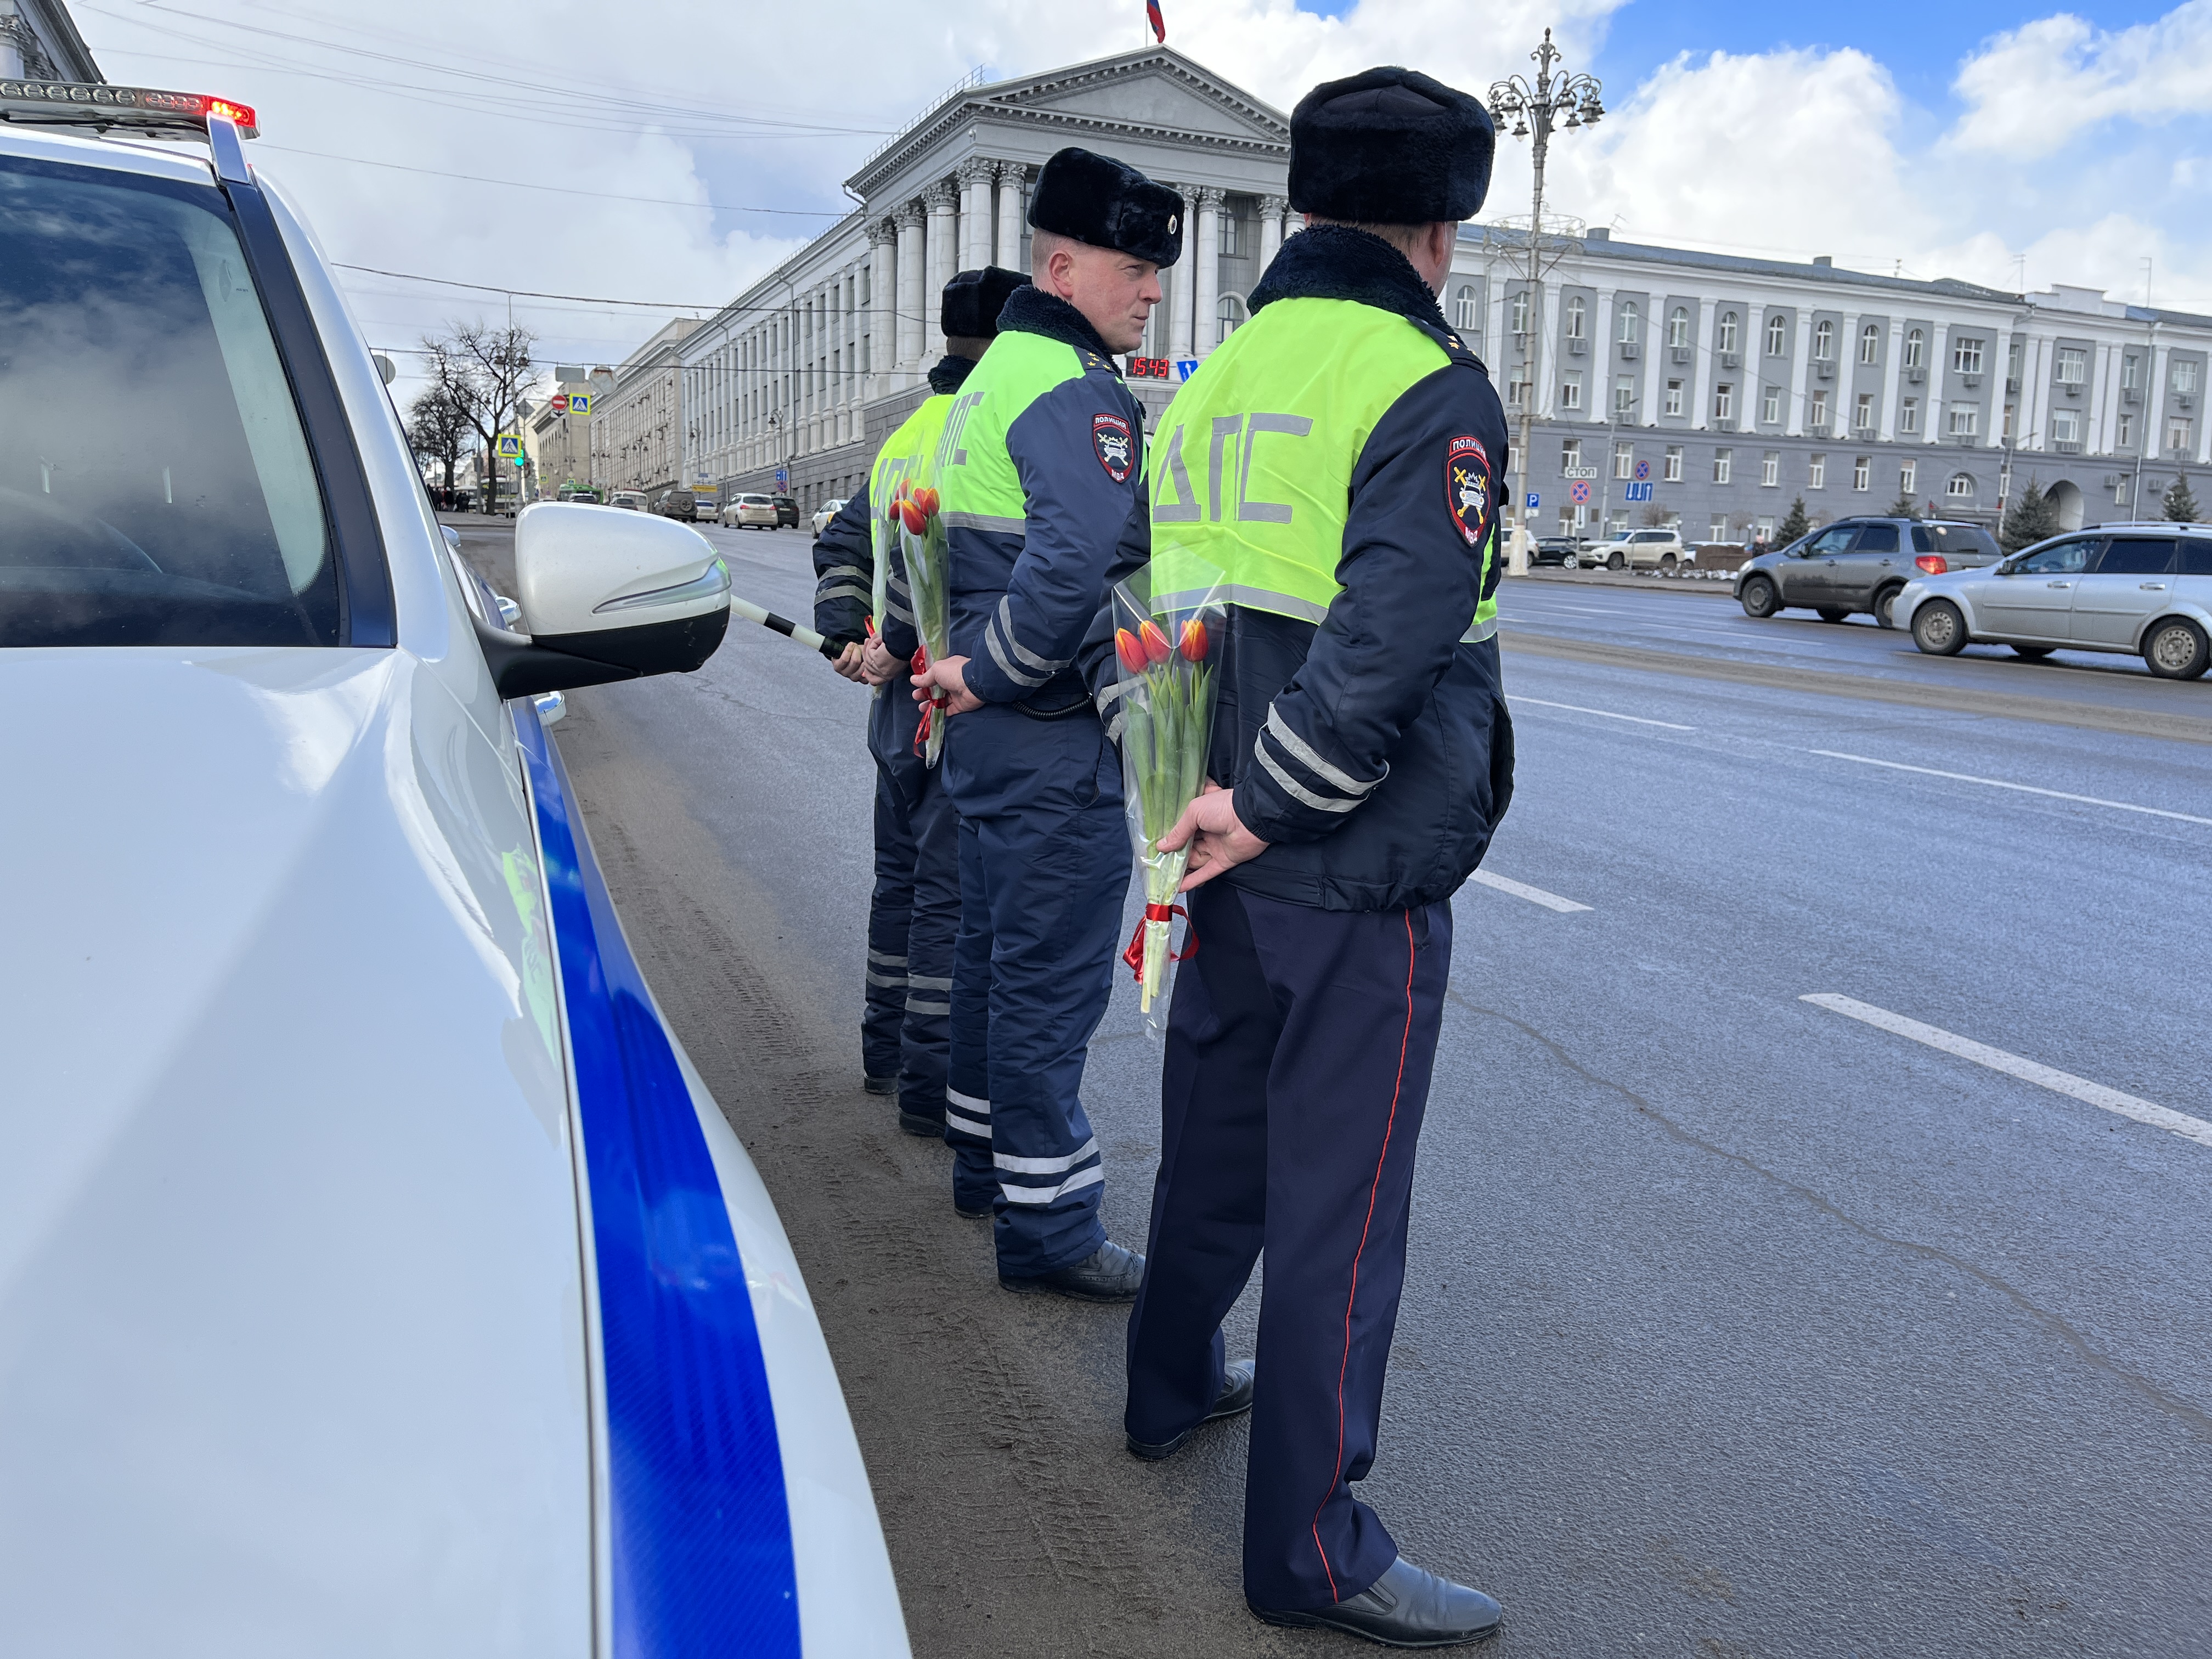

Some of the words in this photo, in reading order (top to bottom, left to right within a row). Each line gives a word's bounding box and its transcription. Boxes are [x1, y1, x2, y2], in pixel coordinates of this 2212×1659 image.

[1153, 413, 1313, 524] ДПС
[1567, 468, 1595, 477] СТОП
[1530, 495, 1537, 506] P
